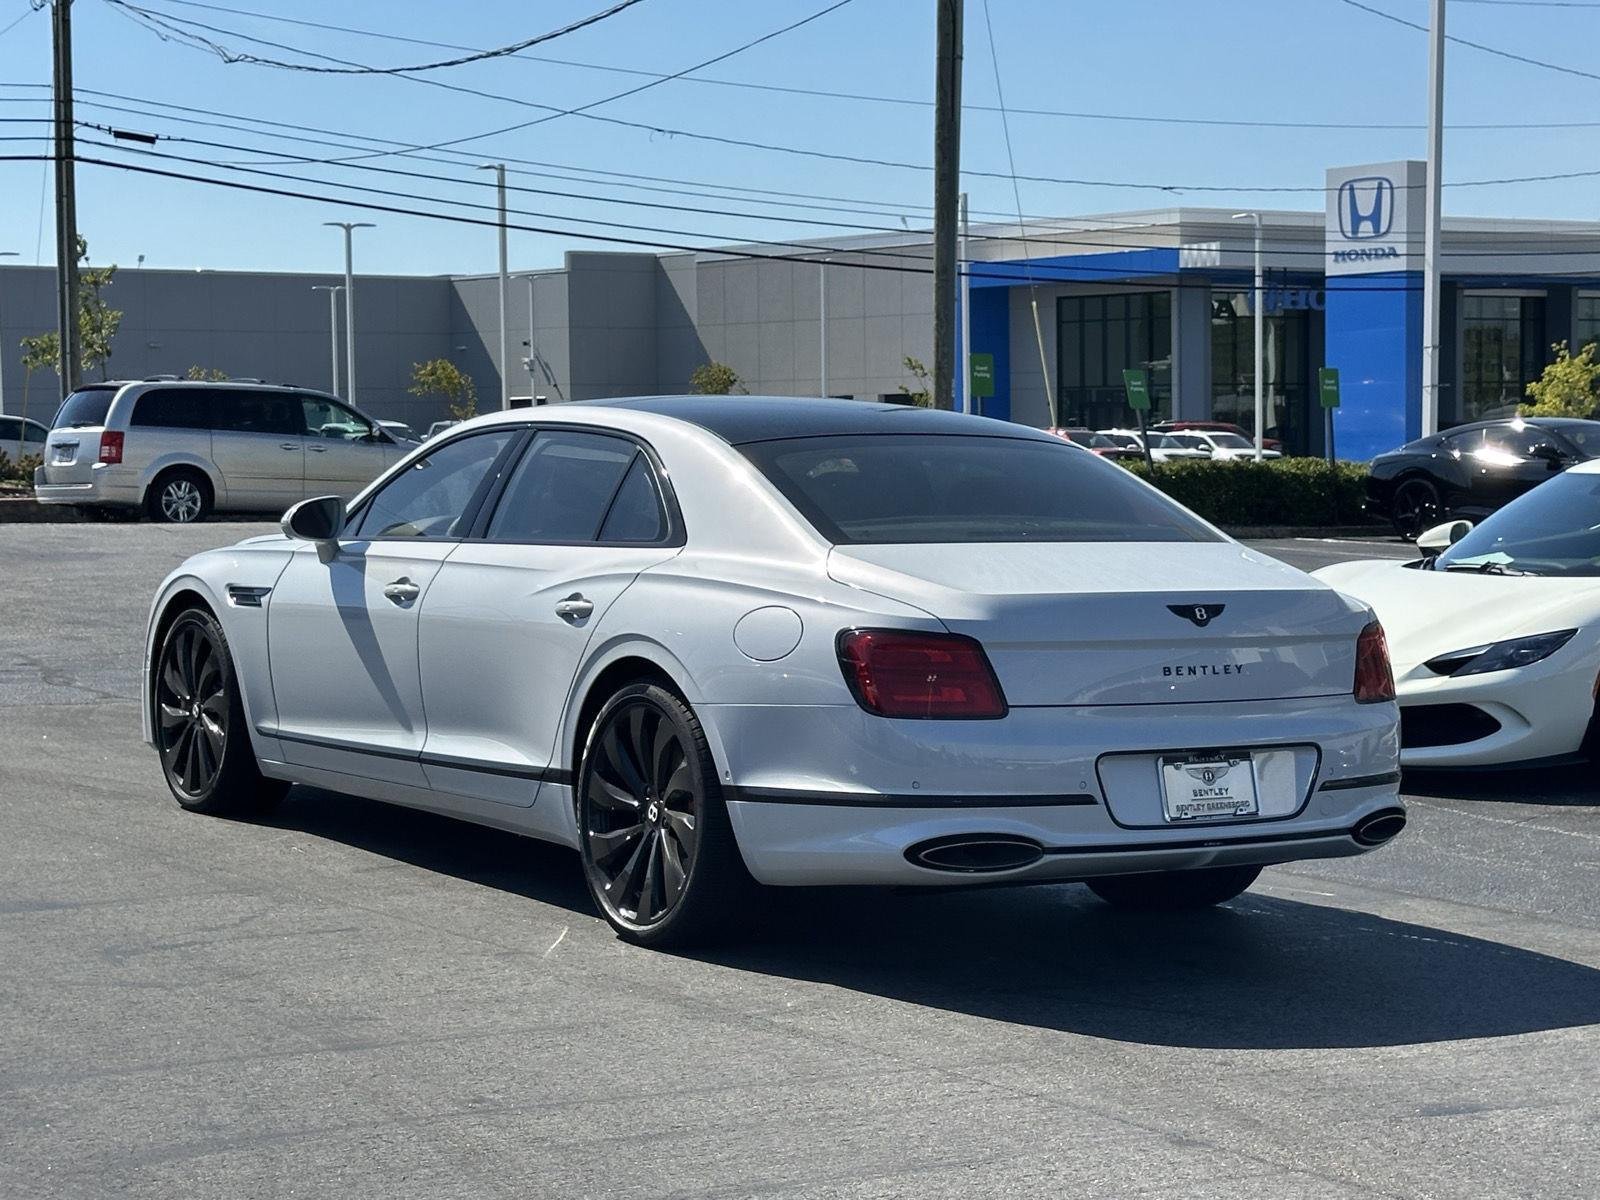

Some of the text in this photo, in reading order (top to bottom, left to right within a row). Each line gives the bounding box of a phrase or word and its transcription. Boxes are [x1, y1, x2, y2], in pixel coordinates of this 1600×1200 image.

[1332, 245, 1399, 263] HONDA
[1162, 664, 1243, 677] BENTLEY
[1192, 787, 1229, 797] BENTLEY
